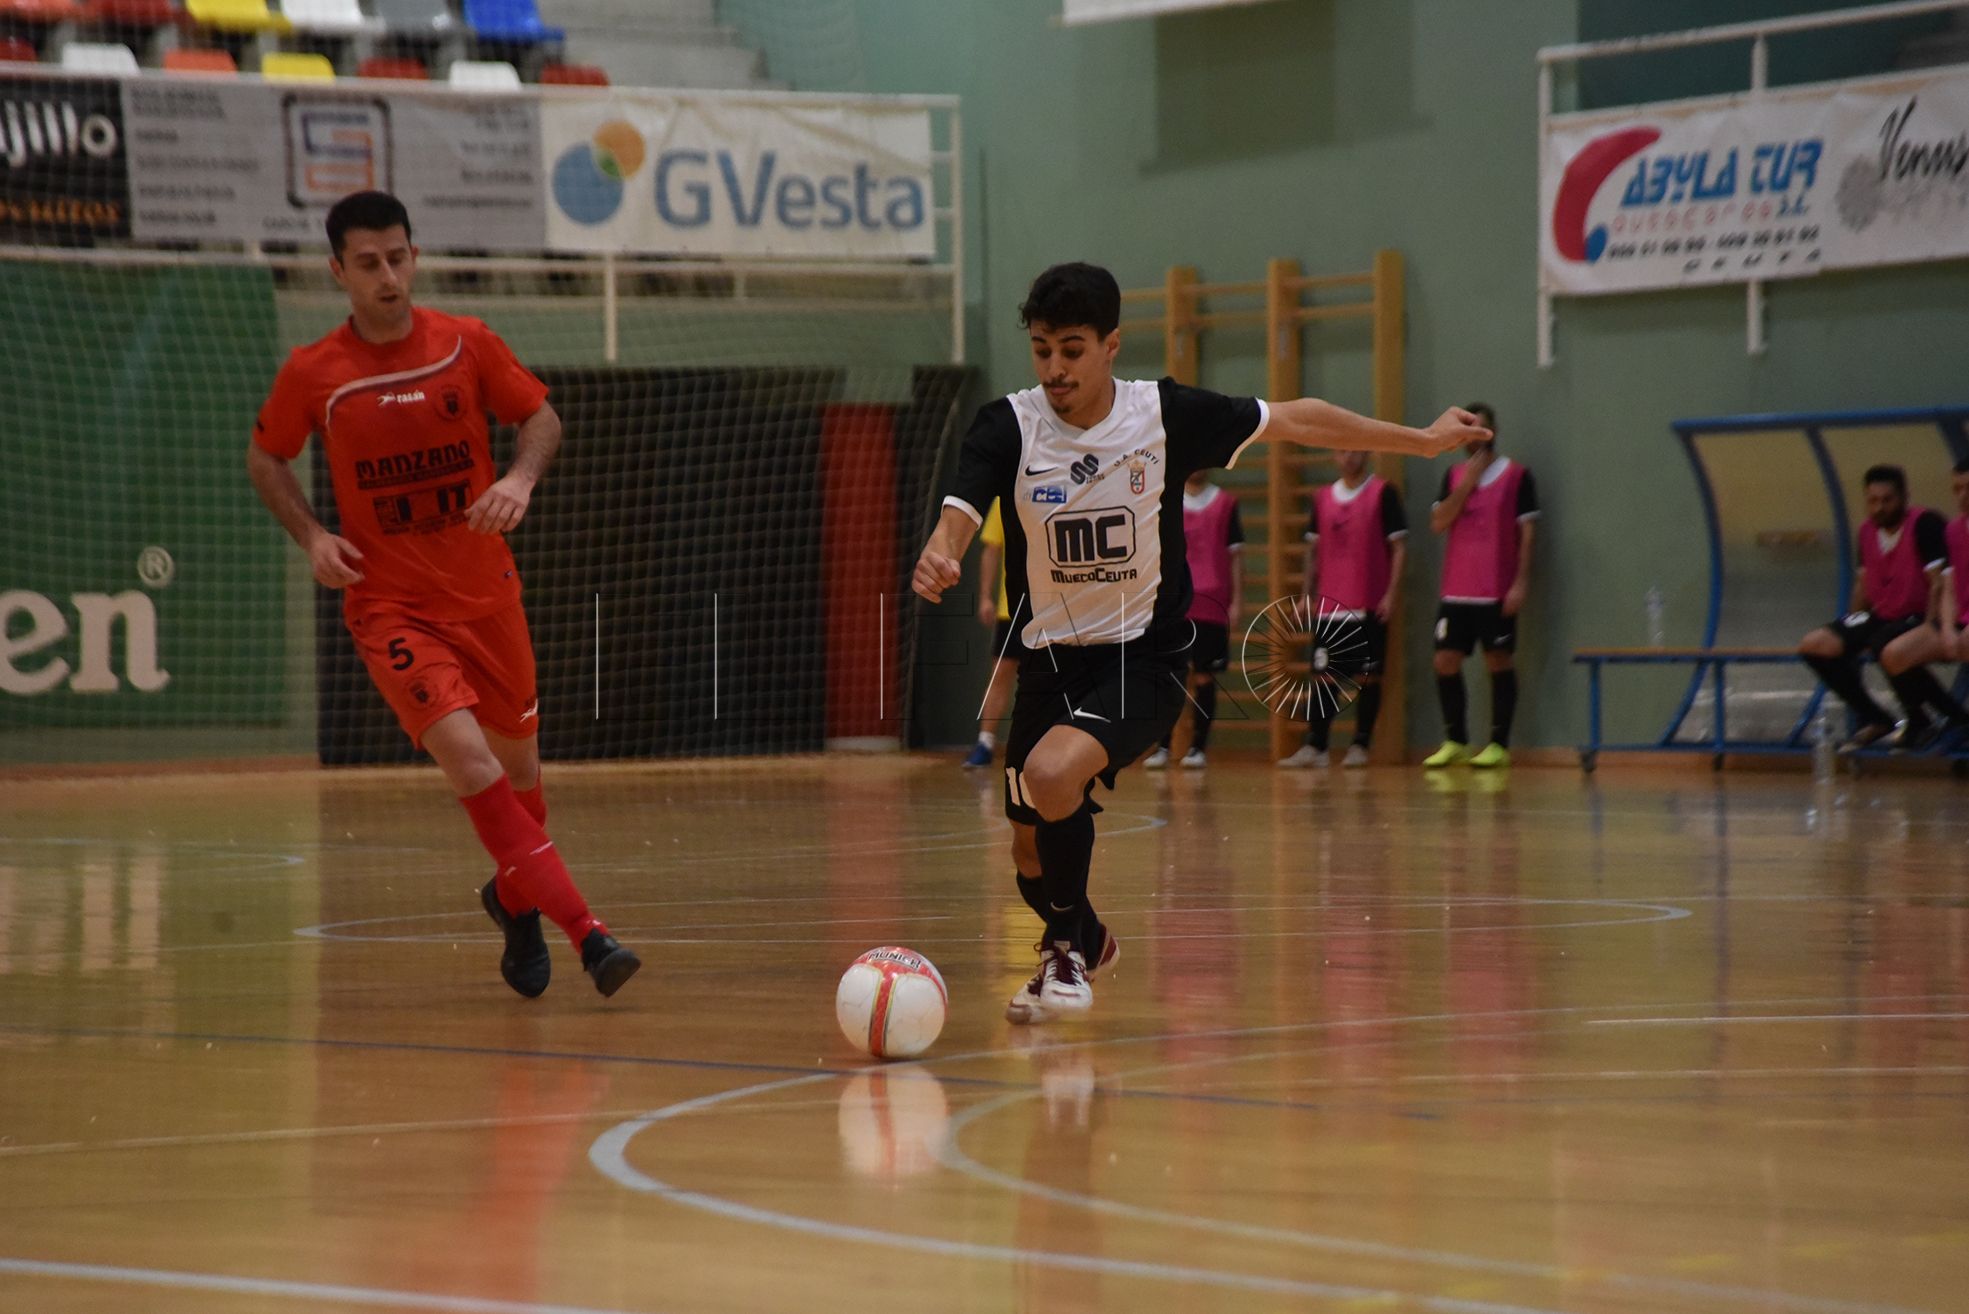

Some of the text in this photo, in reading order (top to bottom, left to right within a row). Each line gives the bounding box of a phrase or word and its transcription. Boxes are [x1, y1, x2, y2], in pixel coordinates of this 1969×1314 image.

[0, 98, 118, 168] jillo
[654, 148, 926, 232] GVesta
[1054, 514, 1128, 562] MC
[388, 636, 415, 672] 5
[868, 951, 922, 969] MUNICH
